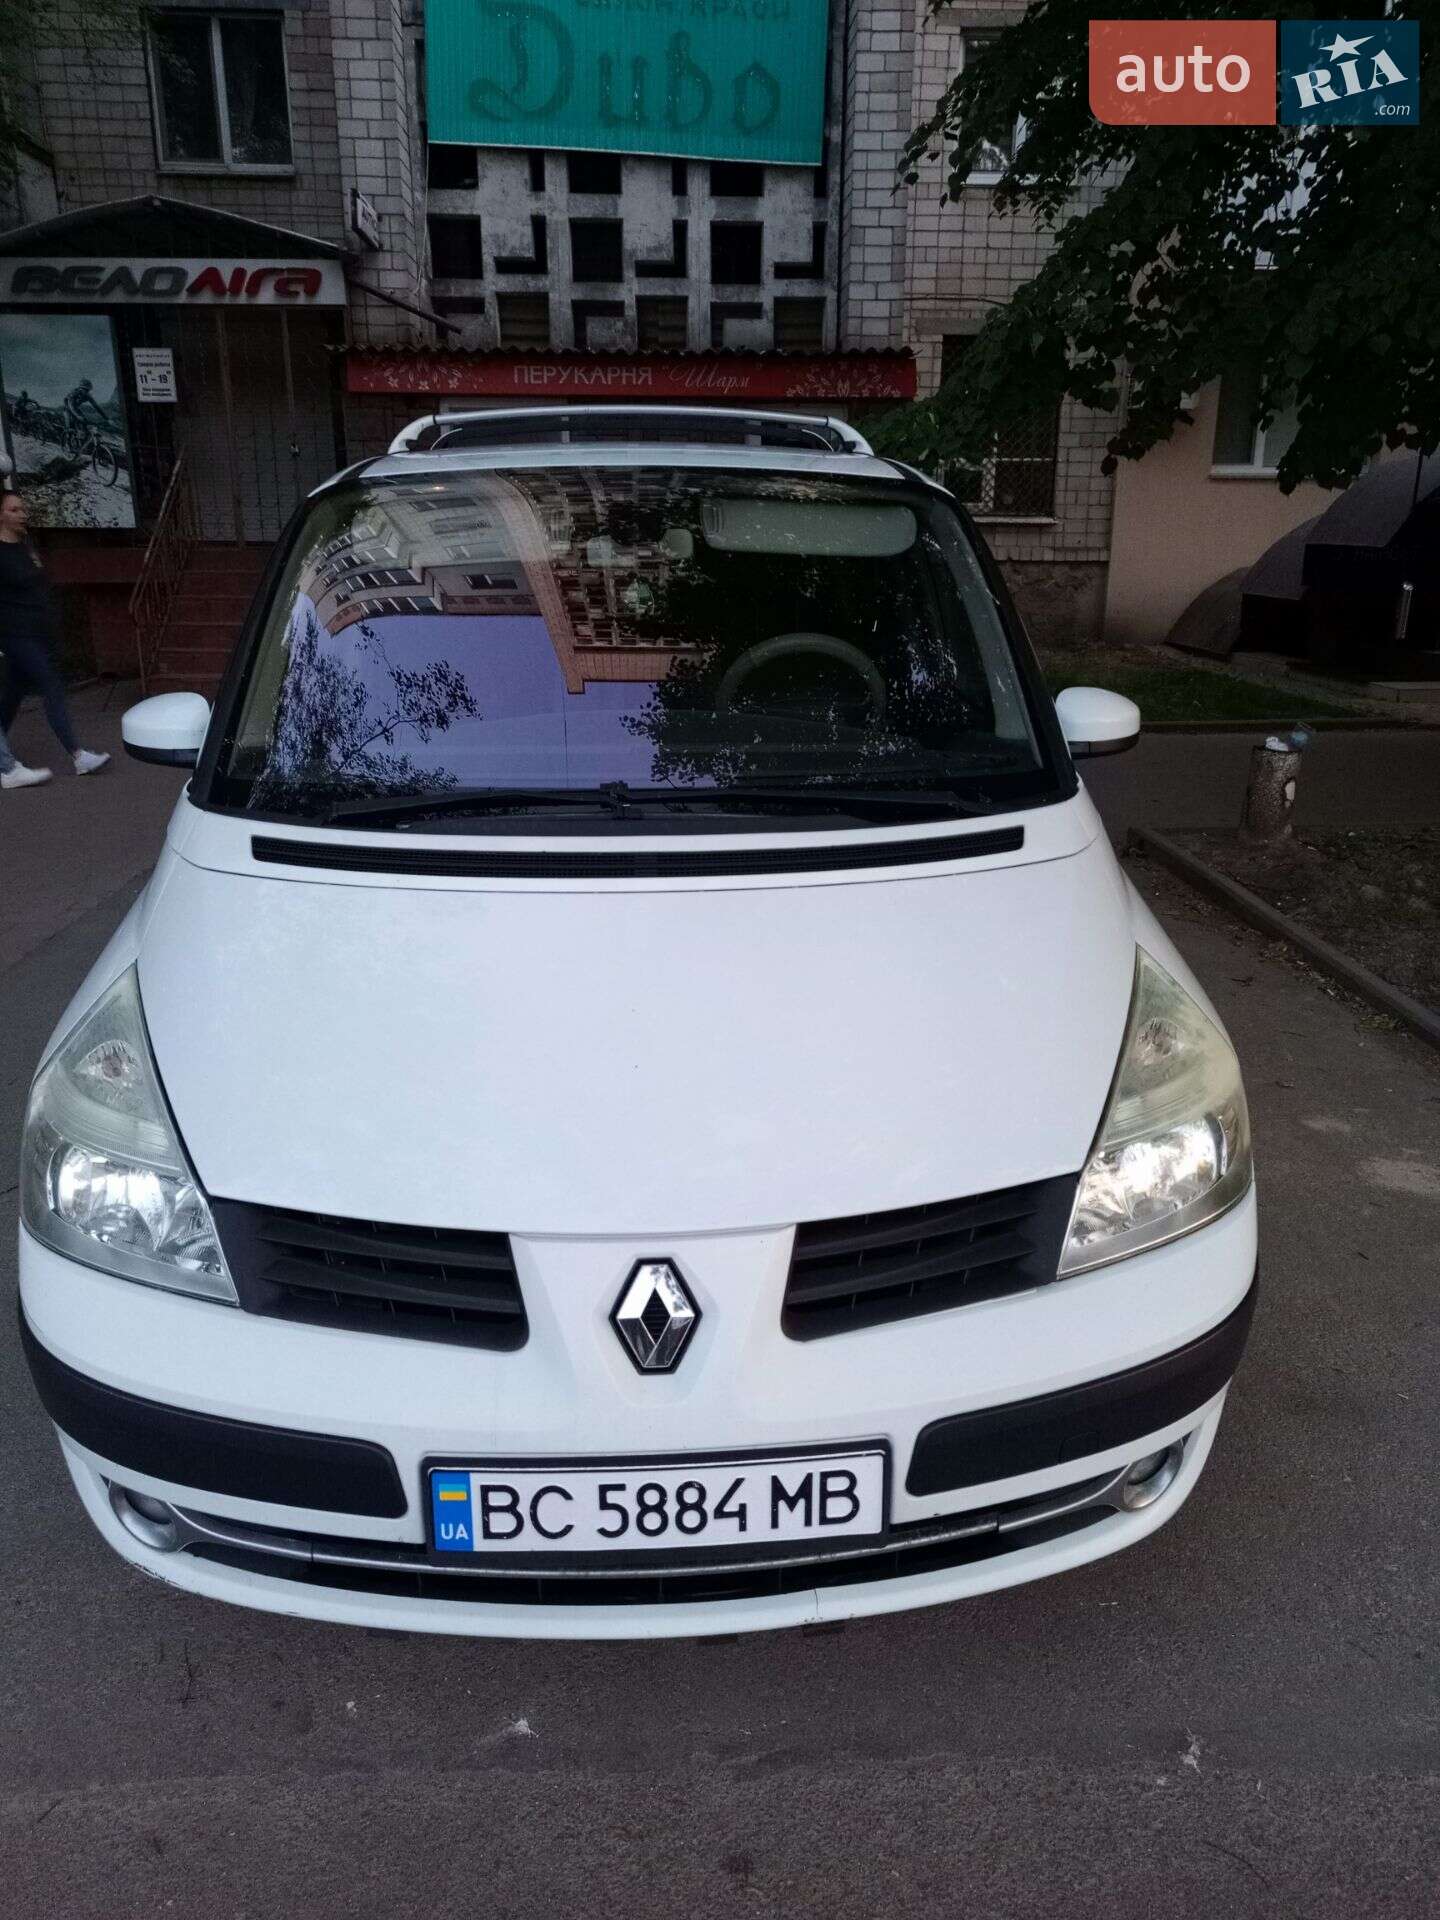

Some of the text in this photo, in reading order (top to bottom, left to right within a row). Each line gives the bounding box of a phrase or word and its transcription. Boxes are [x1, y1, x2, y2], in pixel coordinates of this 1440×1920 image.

[513, 365, 653, 385] ПЕРУКАРНЯ
[480, 1469, 861, 1540] BC 5884 MB
[440, 1523, 469, 1541] UA
